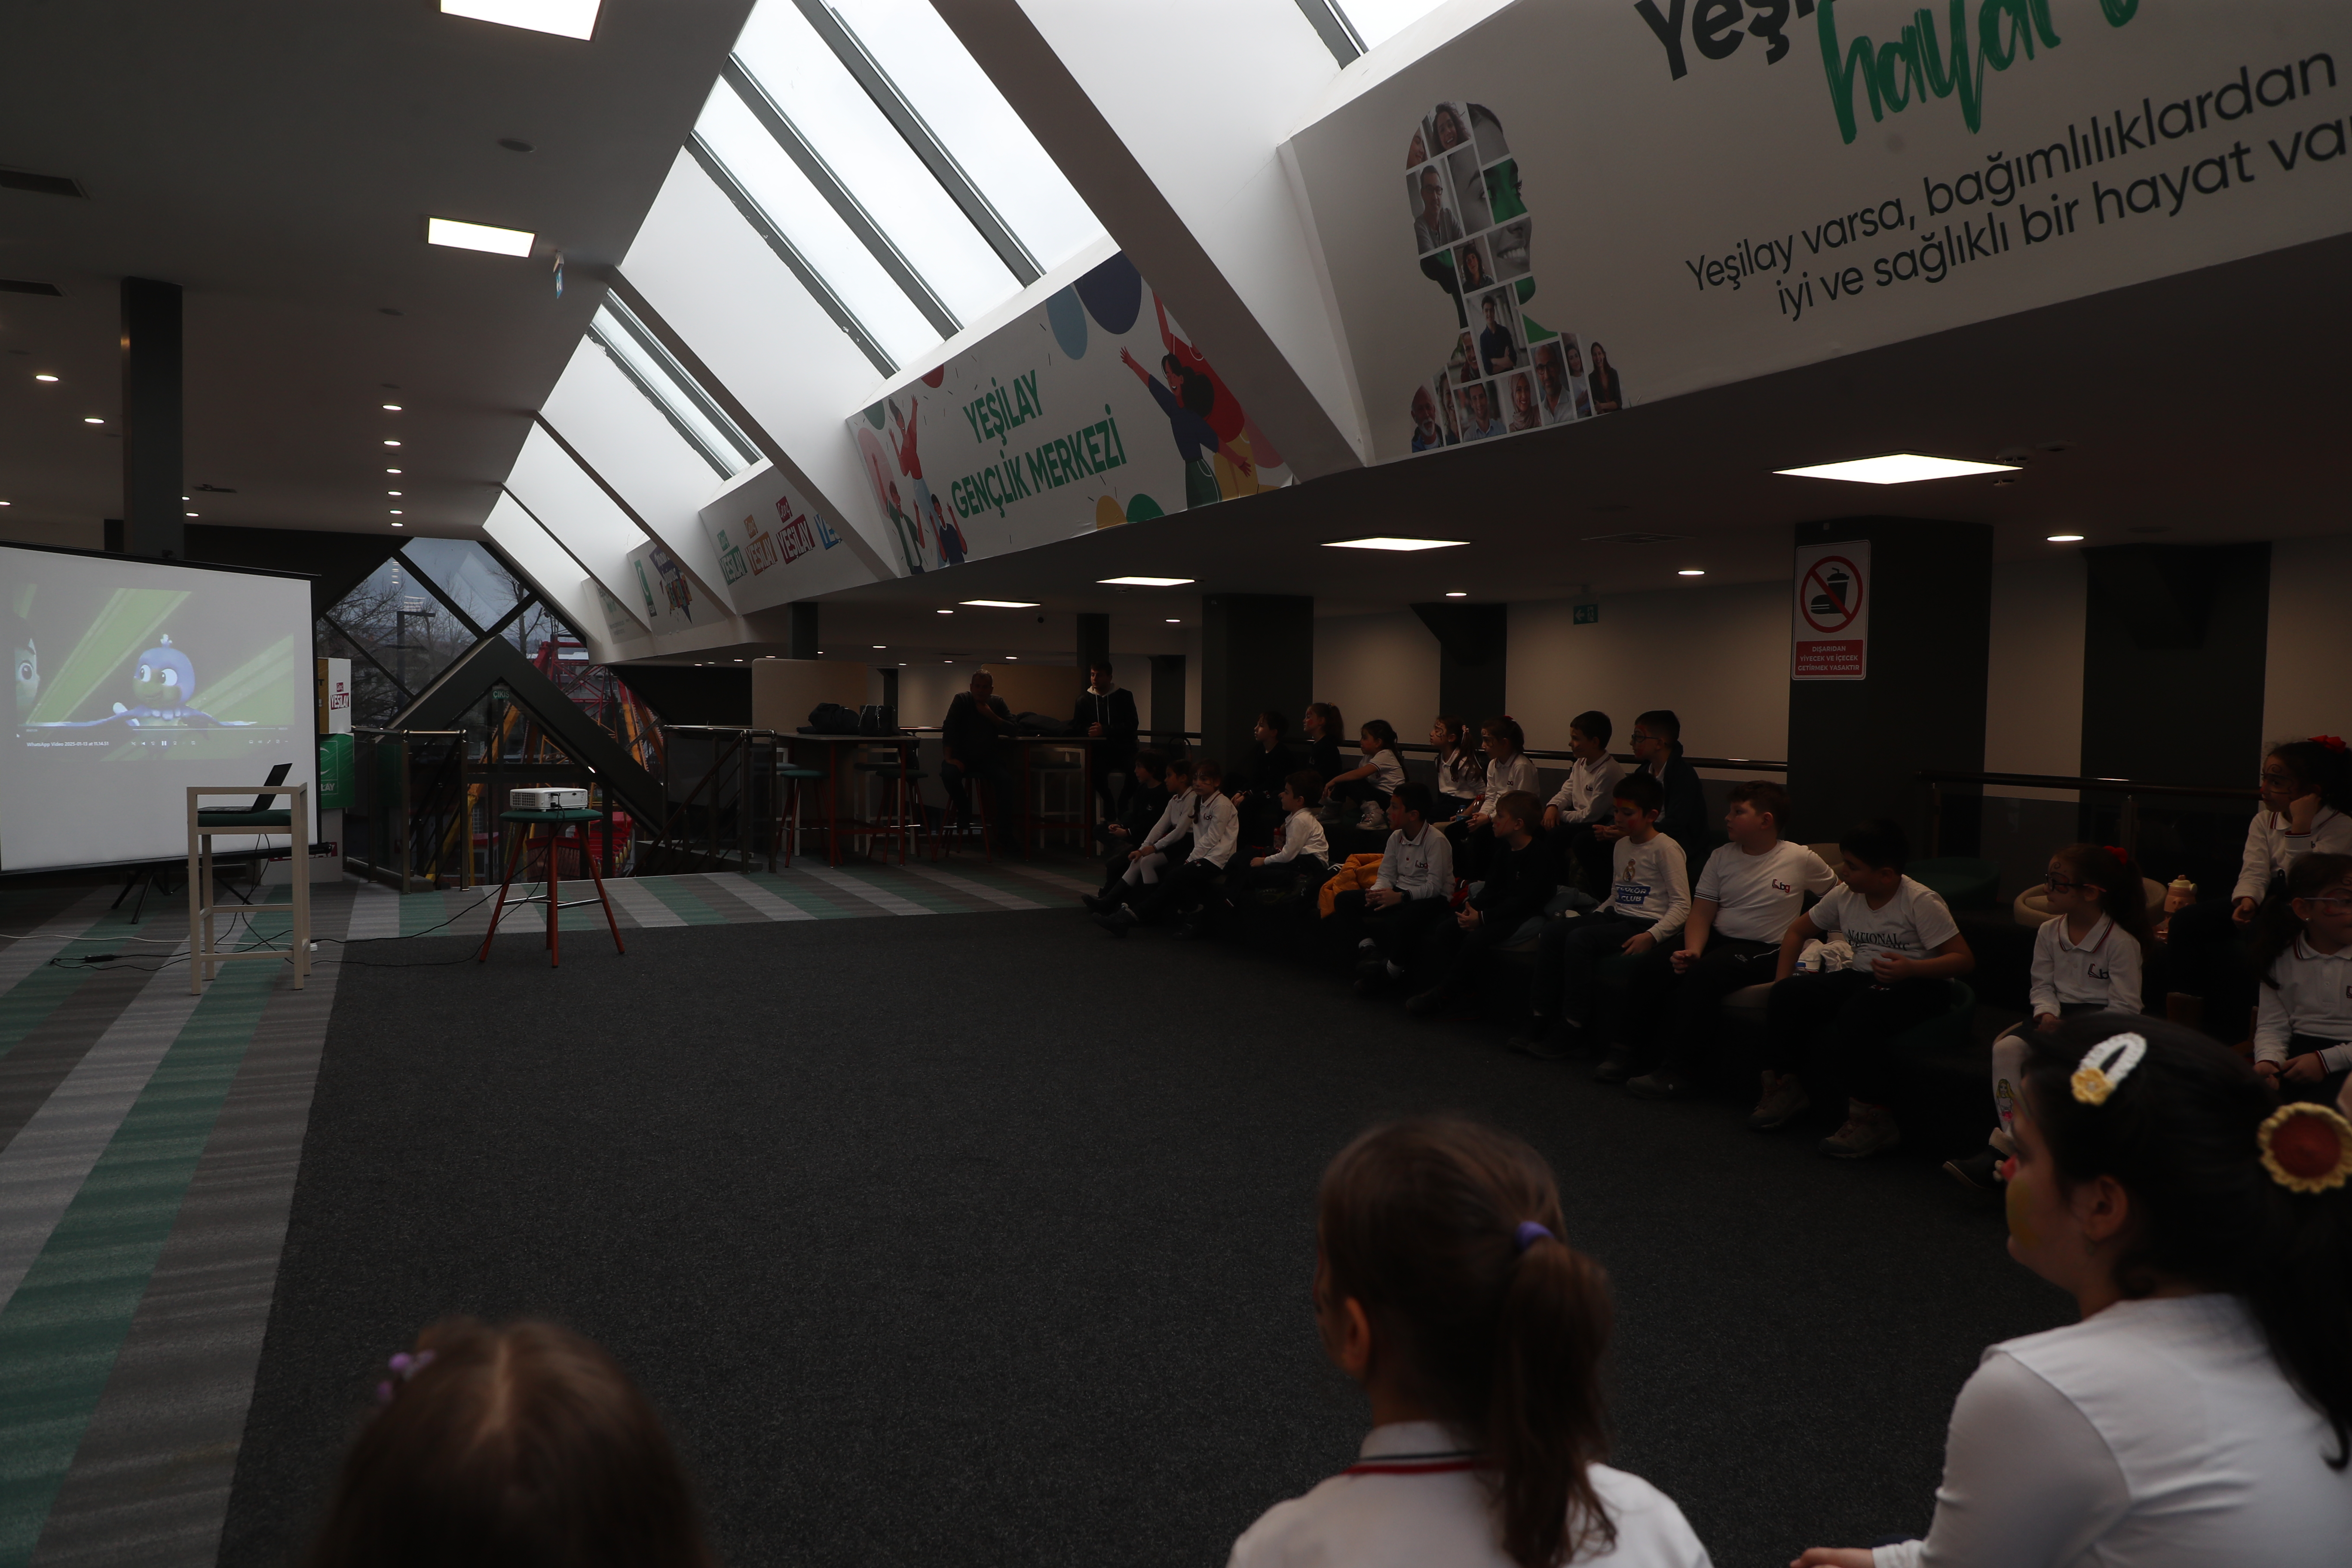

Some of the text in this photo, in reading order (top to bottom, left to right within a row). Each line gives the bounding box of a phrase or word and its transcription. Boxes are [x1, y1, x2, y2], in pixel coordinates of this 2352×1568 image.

[1685, 52, 2337, 292] Yeşilay varsa, bağımlılıklardan
[1776, 115, 2352, 322] iyi ve sağlıklı bir hayat va
[962, 370, 1043, 446] YEŞİLAY
[951, 403, 1127, 518] GENÇLİK MERKEZİ
[1836, 654, 1858, 662] İÇECEK
[1848, 929, 1902, 945] NATIONAL
